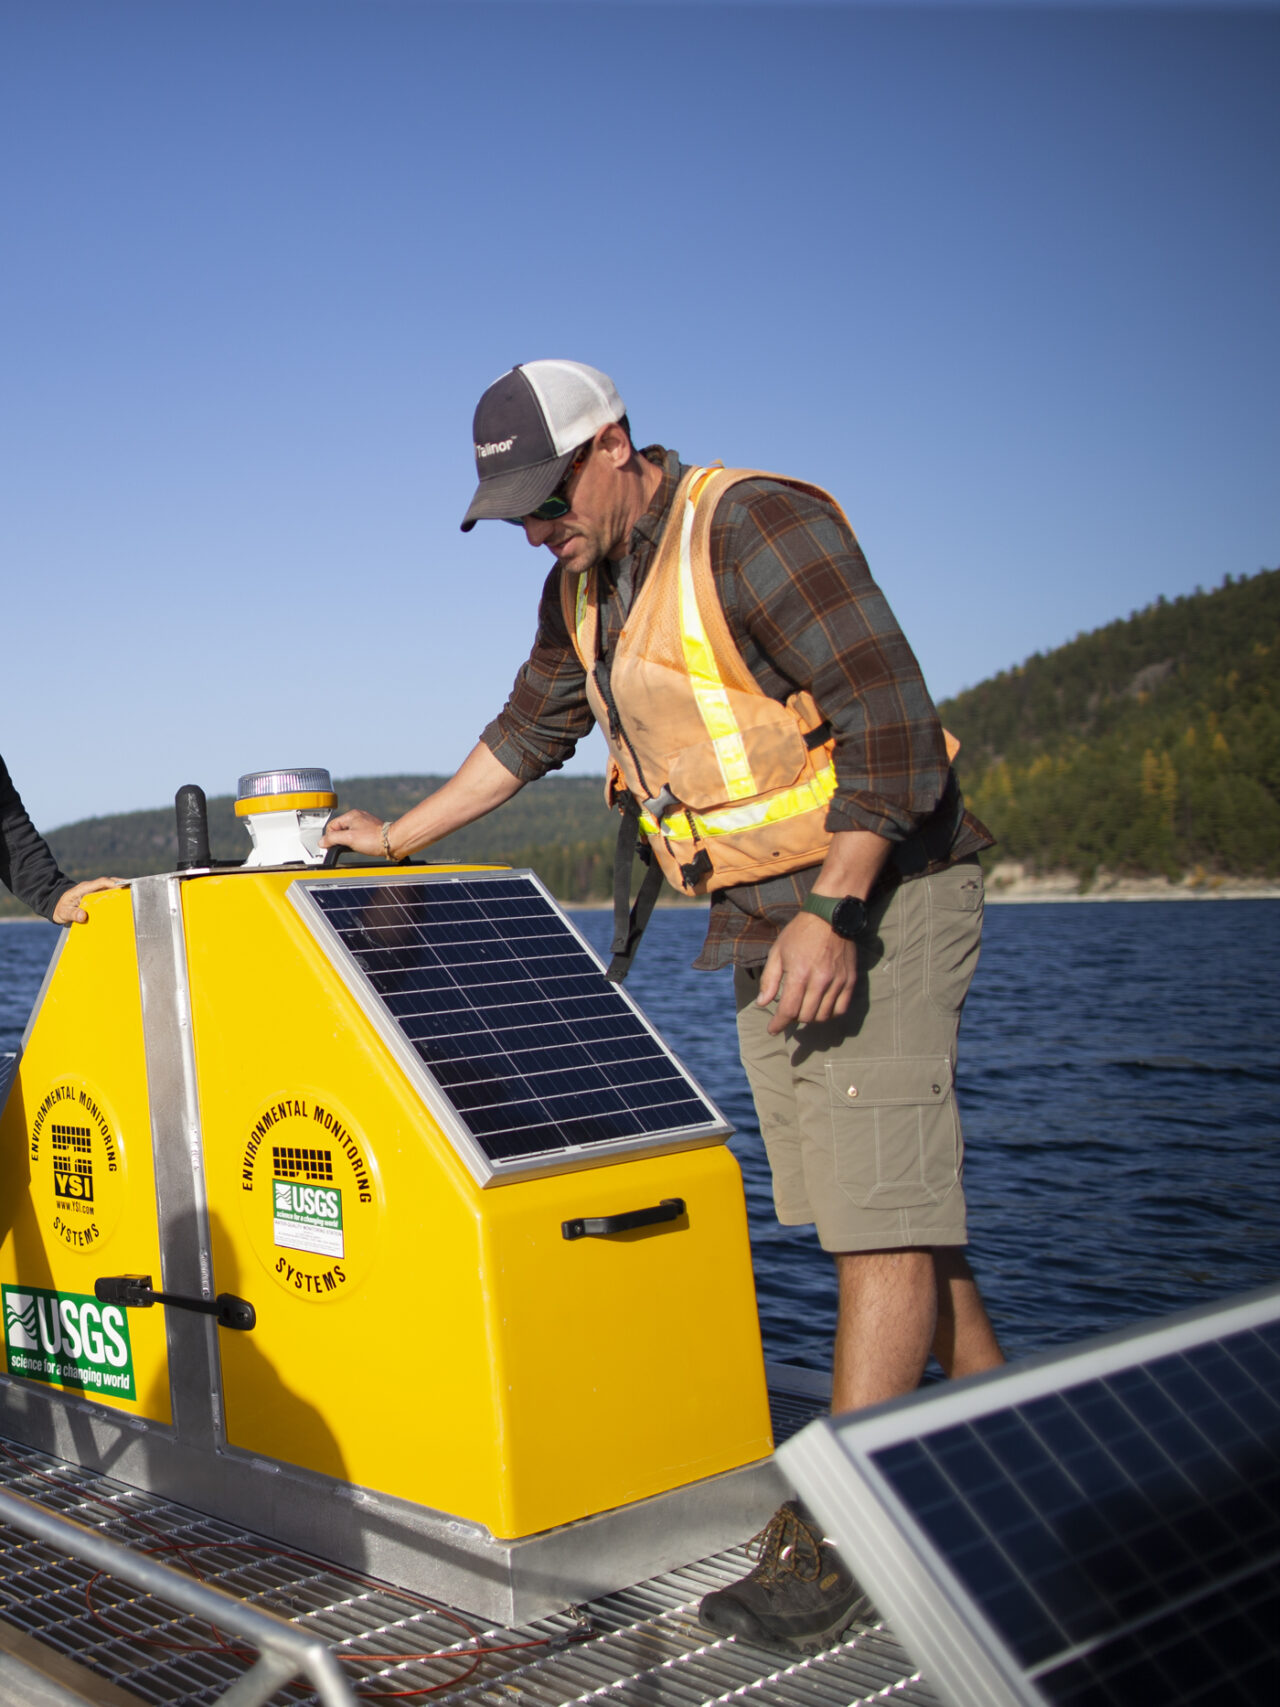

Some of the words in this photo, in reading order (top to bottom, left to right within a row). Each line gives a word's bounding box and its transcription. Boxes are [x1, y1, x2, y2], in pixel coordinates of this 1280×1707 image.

[31, 1086, 76, 1162] ENVIRONMENTAL
[79, 1091, 118, 1172] MONITORING
[243, 1100, 308, 1191] ENVIRONMENTAL
[313, 1105, 372, 1203] MONITORING
[55, 1173, 92, 1199] YSI
[292, 1185, 339, 1218] USGS
[53, 1217, 100, 1247] SYSTEMS
[275, 1257, 346, 1293] SYSTEMS
[37, 1296, 128, 1367] USGS
[11, 1354, 42, 1371] science
[43, 1358, 56, 1374] for
[56, 1364, 62, 1375] a
[63, 1363, 102, 1387] changing
[103, 1373, 130, 1390] world
